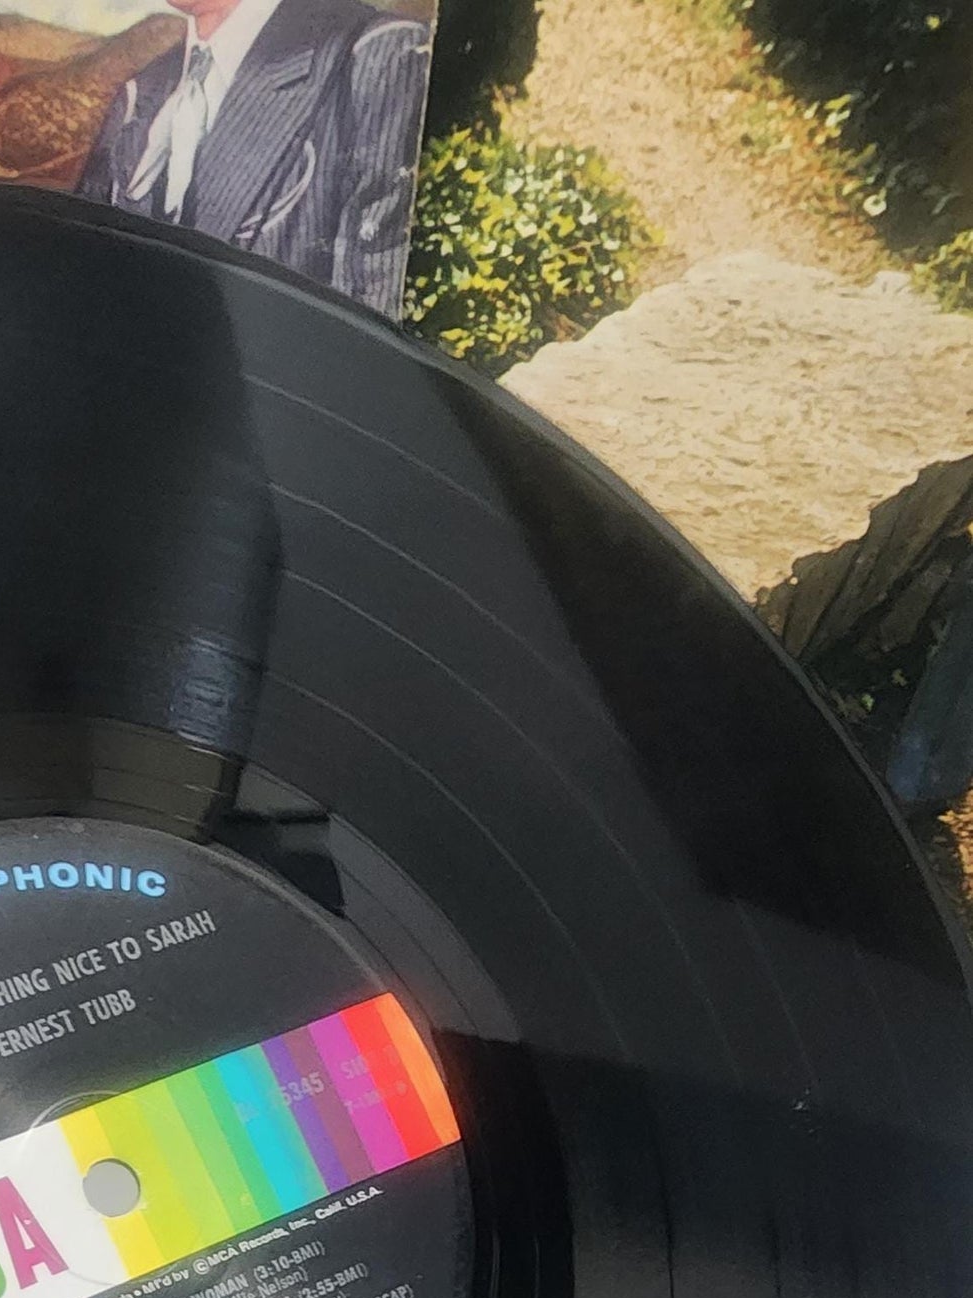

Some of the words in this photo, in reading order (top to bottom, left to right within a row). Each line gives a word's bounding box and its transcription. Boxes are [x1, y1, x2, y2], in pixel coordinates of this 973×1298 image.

[51, 948, 107, 985] NICE
[106, 936, 142, 965] TO
[145, 910, 216, 952] SARAH
[78, 988, 136, 1025] TUBB
[171, 1269, 190, 1282] by
[345, 1186, 384, 1206] U.S.A.
[252, 1240, 325, 1285] (3:10-BMI)
